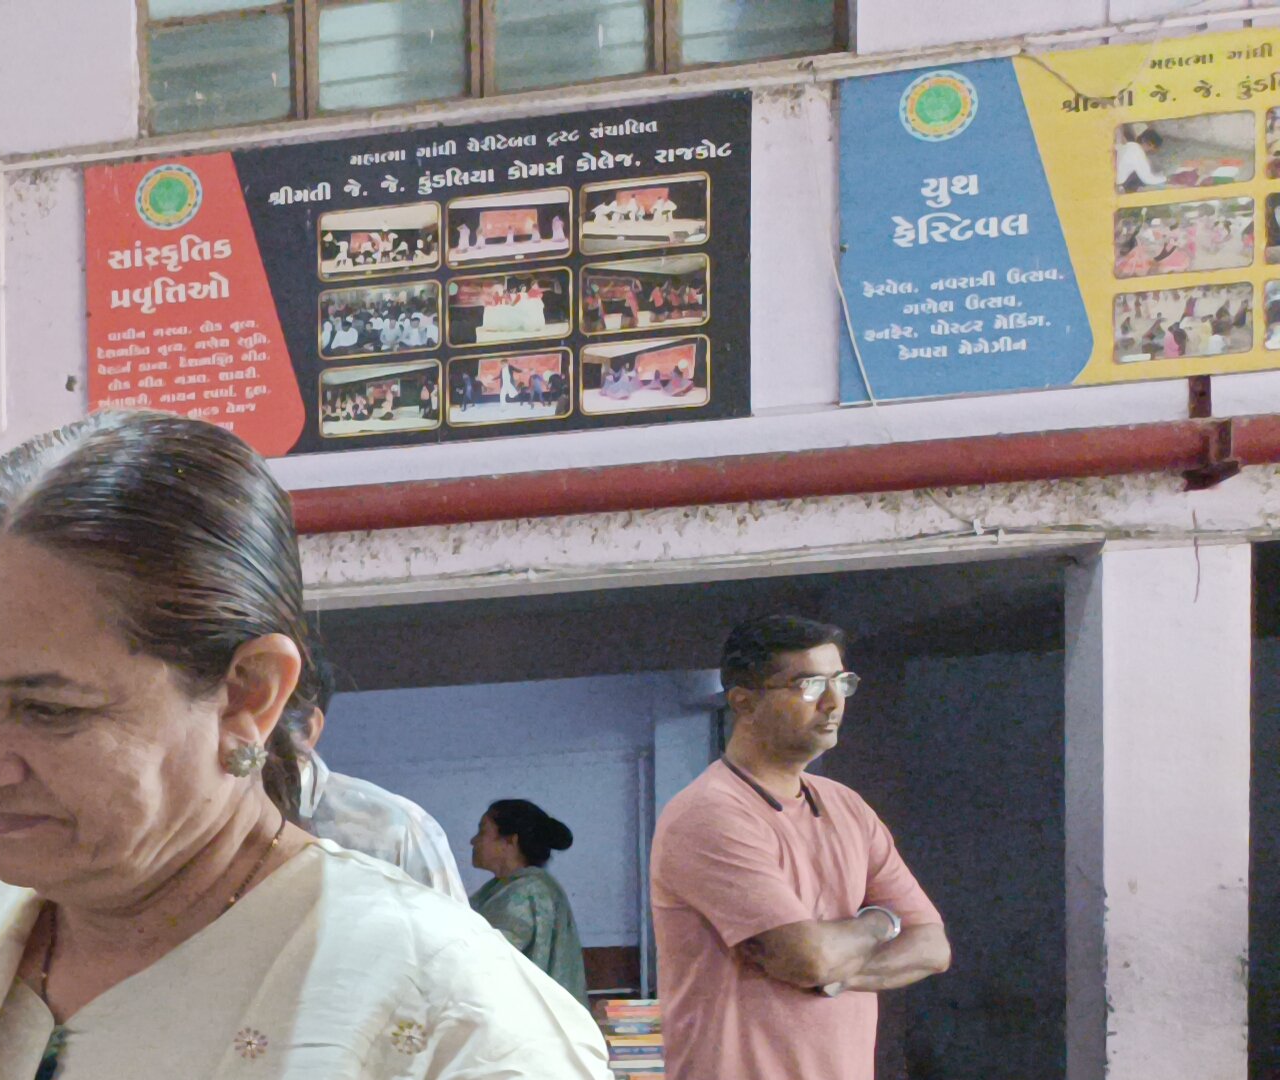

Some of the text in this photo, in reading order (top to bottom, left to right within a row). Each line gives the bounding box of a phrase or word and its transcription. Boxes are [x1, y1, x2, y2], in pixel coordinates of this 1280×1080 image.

[1149, 53, 1214, 70] મહાત્મા
[349, 149, 406, 166] મહાત્મા
[416, 140, 457, 158] ગાંધી
[466, 133, 537, 153] ચેરીટેબલ
[589, 118, 658, 139] સંચાલિત
[268, 182, 331, 206] શ્રીમતી
[343, 178, 368, 197] જે.
[380, 174, 405, 193] જે.
[417, 166, 495, 196] કુંડલિયા
[507, 154, 564, 180] કોમર્સ
[654, 138, 732, 163] રાજકોટ
[920, 174, 979, 208] યુથ
[891, 211, 1029, 248] ફેસ્ટિવલ
[107, 233, 232, 272] સાંસ્કૃતિક
[930, 270, 996, 291] નવરાત્રી
[902, 298, 954, 315] ગણેશ
[930, 319, 984, 336] પોસ્ટર
